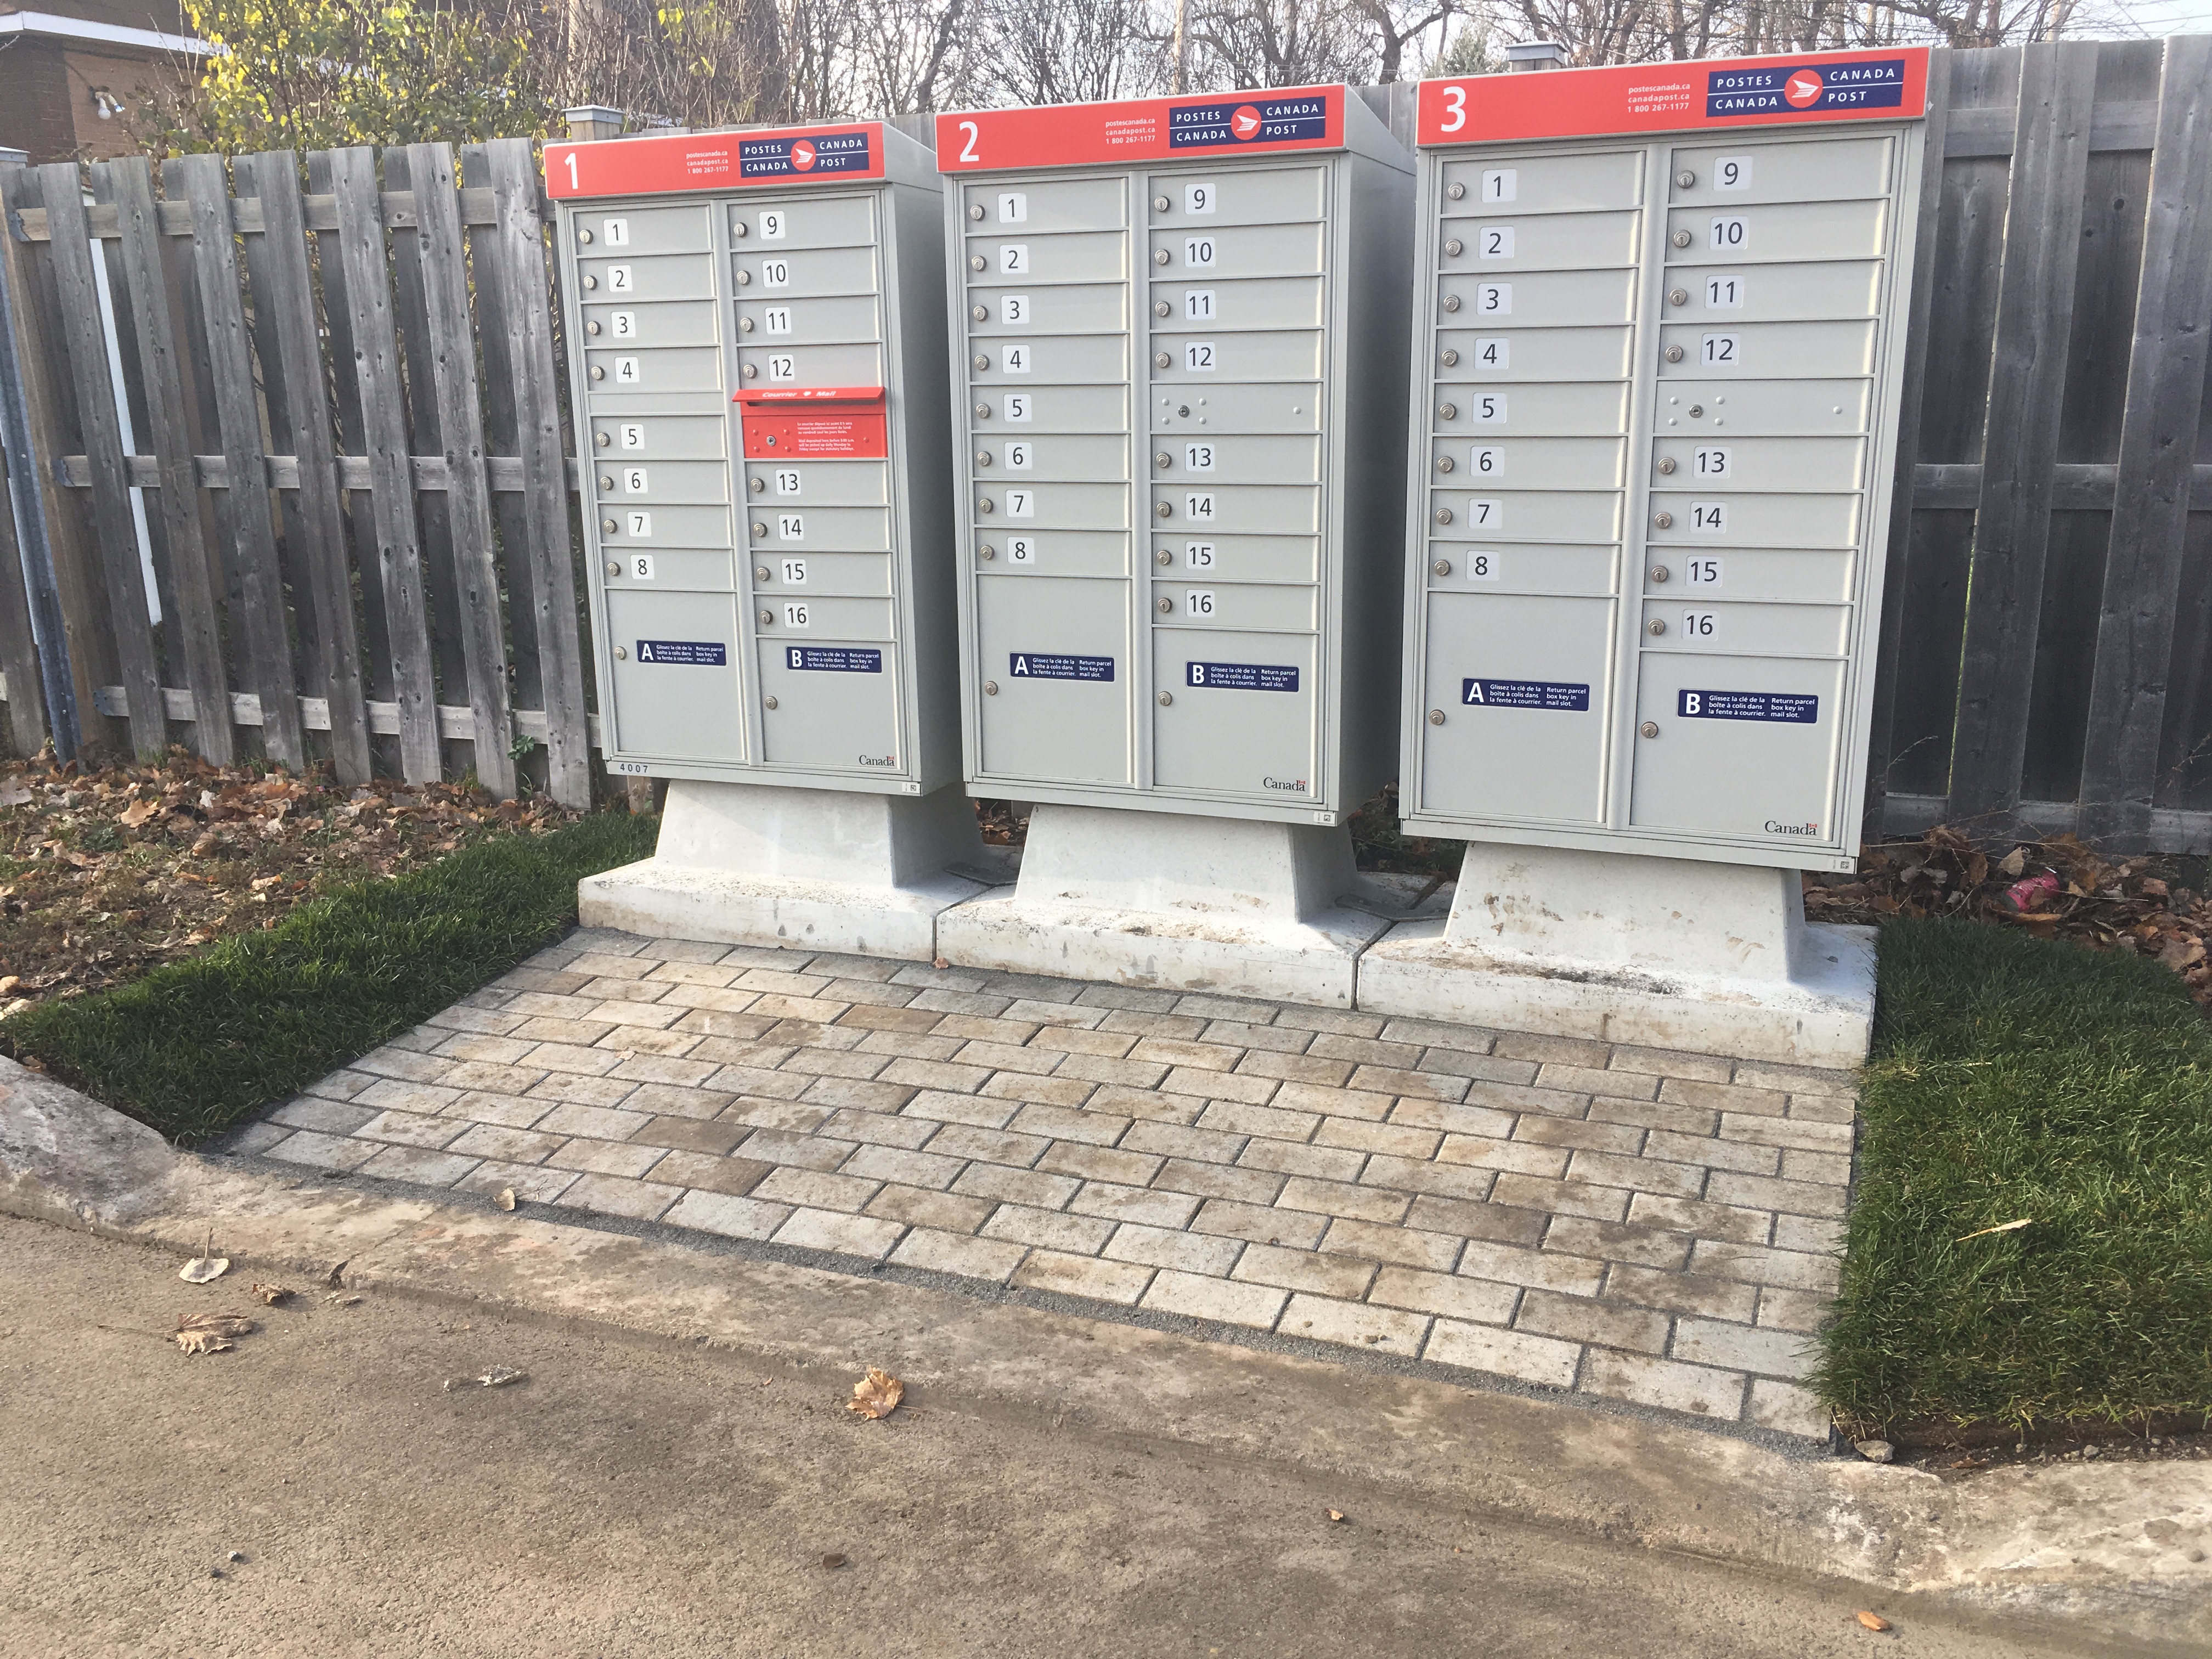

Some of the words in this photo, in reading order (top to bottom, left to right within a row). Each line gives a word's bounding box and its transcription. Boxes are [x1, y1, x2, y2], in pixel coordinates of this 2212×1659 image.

[1717, 75, 1772, 87] POSTES
[1830, 68, 1895, 81] CANADA
[1628, 83, 1690, 94] postescanada.ca
[1628, 93, 1690, 103] canadapost.ca
[1441, 86, 1465, 132] 3
[1652, 102, 1689, 111] 267-1177
[1716, 97, 1778, 109] CANADA
[1829, 92, 1866, 102] POST
[1105, 118, 1155, 127] postescanada.ca
[1176, 111, 1220, 122] POSTES
[1266, 104, 1318, 116] CANADA
[1106, 127, 1155, 136] canadapost.ca
[1176, 130, 1226, 142] CANADA
[1266, 125, 1297, 135] POST
[745, 145, 782, 154] POSTES
[820, 139, 862, 149] CANADA
[959, 121, 979, 162] 2
[686, 150, 727, 159] postescanada.ca
[564, 153, 578, 190] 1
[746, 161, 788, 171] CANADA
[821, 158, 845, 166] POST
[1724, 162, 1739, 186] 9
[1493, 175, 1502, 198] 1
[1007, 198, 1015, 218] 1
[1193, 189, 1206, 210] 9
[612, 223, 619, 241] 1
[766, 216, 777, 235] 9
[1714, 221, 1743, 245] 10
[1188, 241, 1212, 263] 10
[1488, 232, 1502, 255] 2
[1007, 250, 1019, 269] 2
[615, 269, 625, 288] 2
[766, 263, 786, 283] 10
[1485, 288, 1499, 311] 3
[1709, 280, 1735, 304] 11
[1009, 300, 1020, 320] 3
[1188, 295, 1209, 315] 11
[618, 315, 628, 334] 3
[768, 311, 786, 330] 11
[1009, 349, 1022, 369] 4
[1188, 346, 1212, 367] 12
[1482, 343, 1498, 365] 4
[1705, 338, 1734, 361] 12
[622, 361, 633, 379] 4
[772, 358, 793, 377] 12
[1012, 398, 1023, 418] 5
[1481, 397, 1495, 419] 5
[628, 428, 637, 445] 5
[1012, 446, 1024, 466] 6
[1188, 447, 1211, 467] 13
[1479, 450, 1493, 472] 6
[1697, 451, 1725, 473] 13
[631, 472, 641, 489] 6
[778, 473, 799, 492] 13
[1013, 494, 1024, 513] 7
[1188, 497, 1212, 517] 14
[1477, 503, 1491, 524] 7
[1694, 506, 1722, 528] 14
[634, 516, 644, 533] 7
[782, 518, 803, 536] 14
[1014, 541, 1026, 560] 8
[1189, 546, 1212, 566] 15
[637, 558, 648, 576] 8
[785, 563, 805, 581] 15
[1474, 555, 1488, 577] 8
[1690, 561, 1718, 583] 15
[1189, 594, 1212, 614] 16
[787, 606, 807, 624] 16
[1685, 614, 1713, 636] 16
[641, 644, 653, 660] A
[792, 650, 802, 667] B
[1015, 656, 1029, 674] A
[1193, 665, 1204, 683] B
[1468, 682, 1484, 702] A
[1686, 693, 1700, 714] B
[859, 755, 895, 766] Canada
[1263, 777, 1305, 792] Canada
[1765, 821, 1817, 836] Canada
